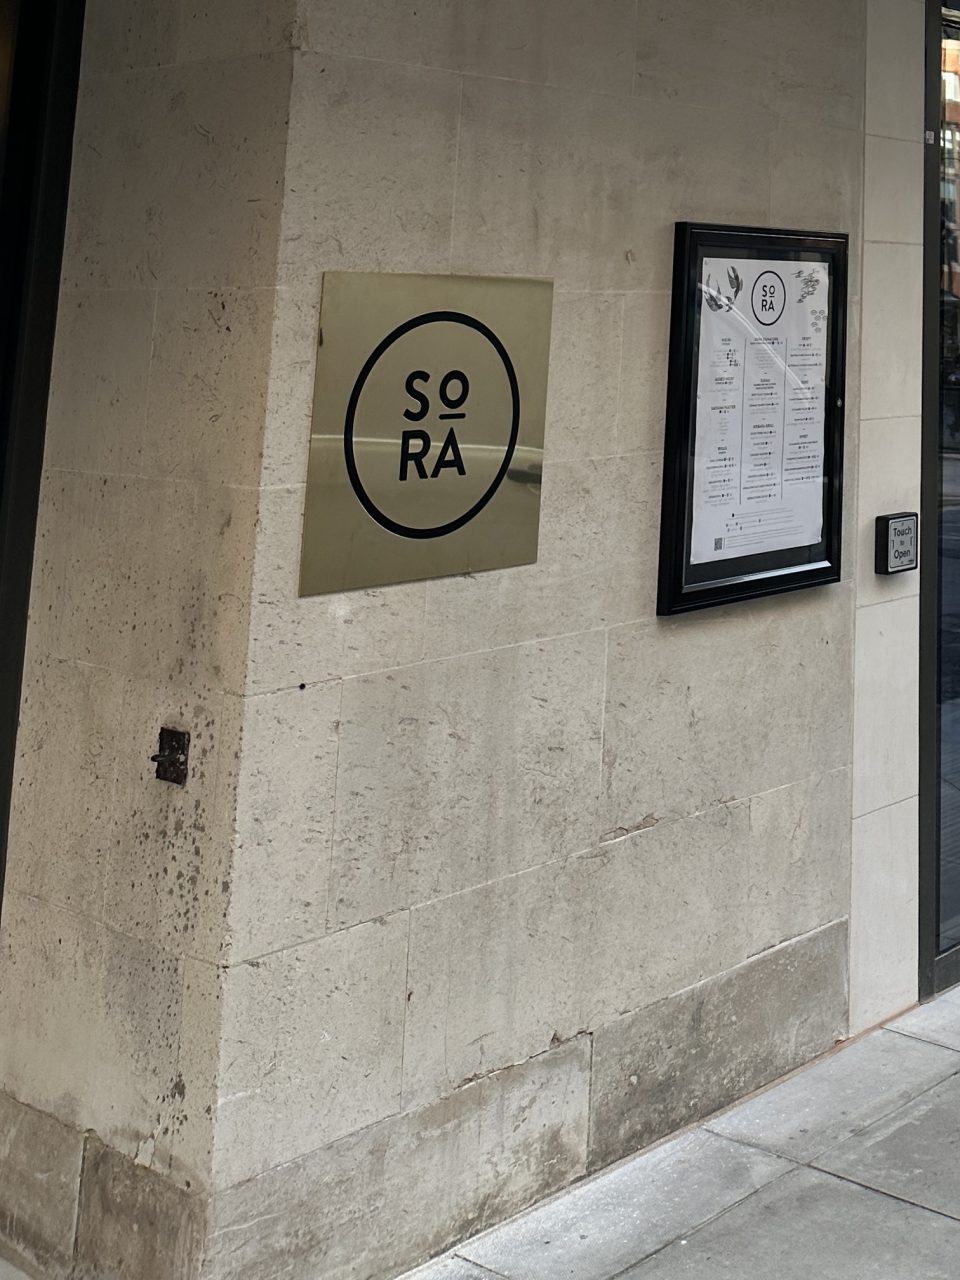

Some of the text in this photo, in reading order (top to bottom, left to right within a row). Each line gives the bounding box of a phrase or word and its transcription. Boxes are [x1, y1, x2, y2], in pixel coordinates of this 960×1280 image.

[398, 426, 467, 481] RA
[893, 526, 912, 537] Touch
[893, 549, 911, 561] Open
